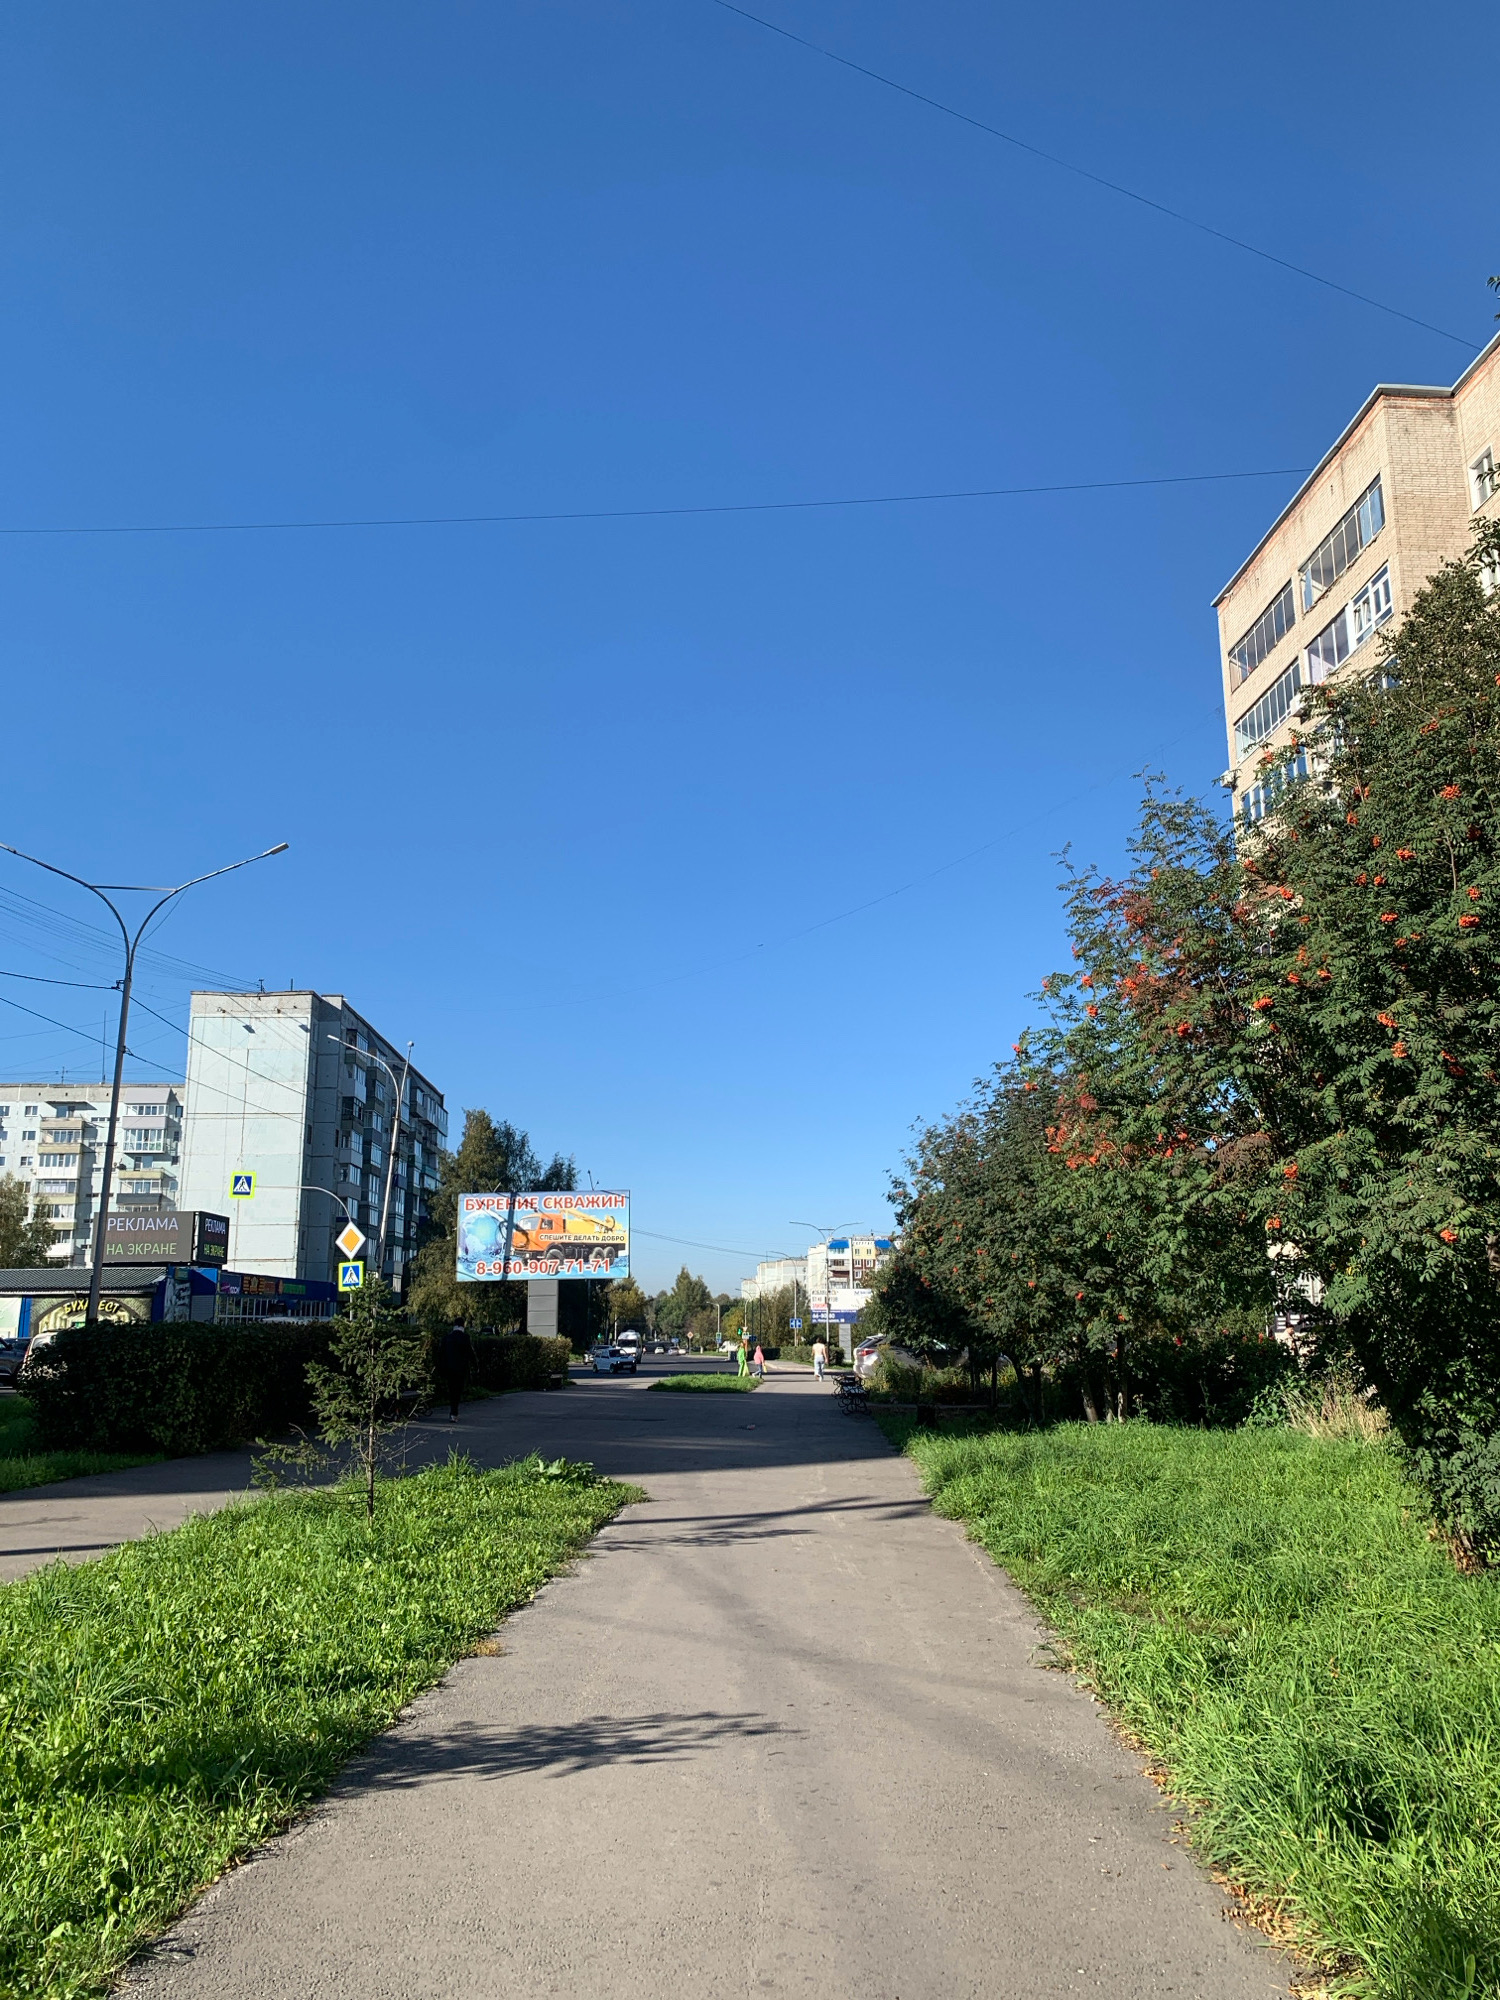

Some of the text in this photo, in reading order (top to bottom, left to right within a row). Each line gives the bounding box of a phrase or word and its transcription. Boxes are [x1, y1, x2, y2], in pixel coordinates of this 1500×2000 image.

[465, 1195, 625, 1211] БУРЕНИЕ СКВАЖИН
[107, 1217, 178, 1231] РЕКЛАМА
[573, 1234, 600, 1242] ДЕЛАТЬ
[106, 1242, 177, 1255] НА ЭКРАНЕ
[477, 1260, 609, 1275] 8-960-907-71-71
[63, 1297, 119, 1313] БУХЕСТ
